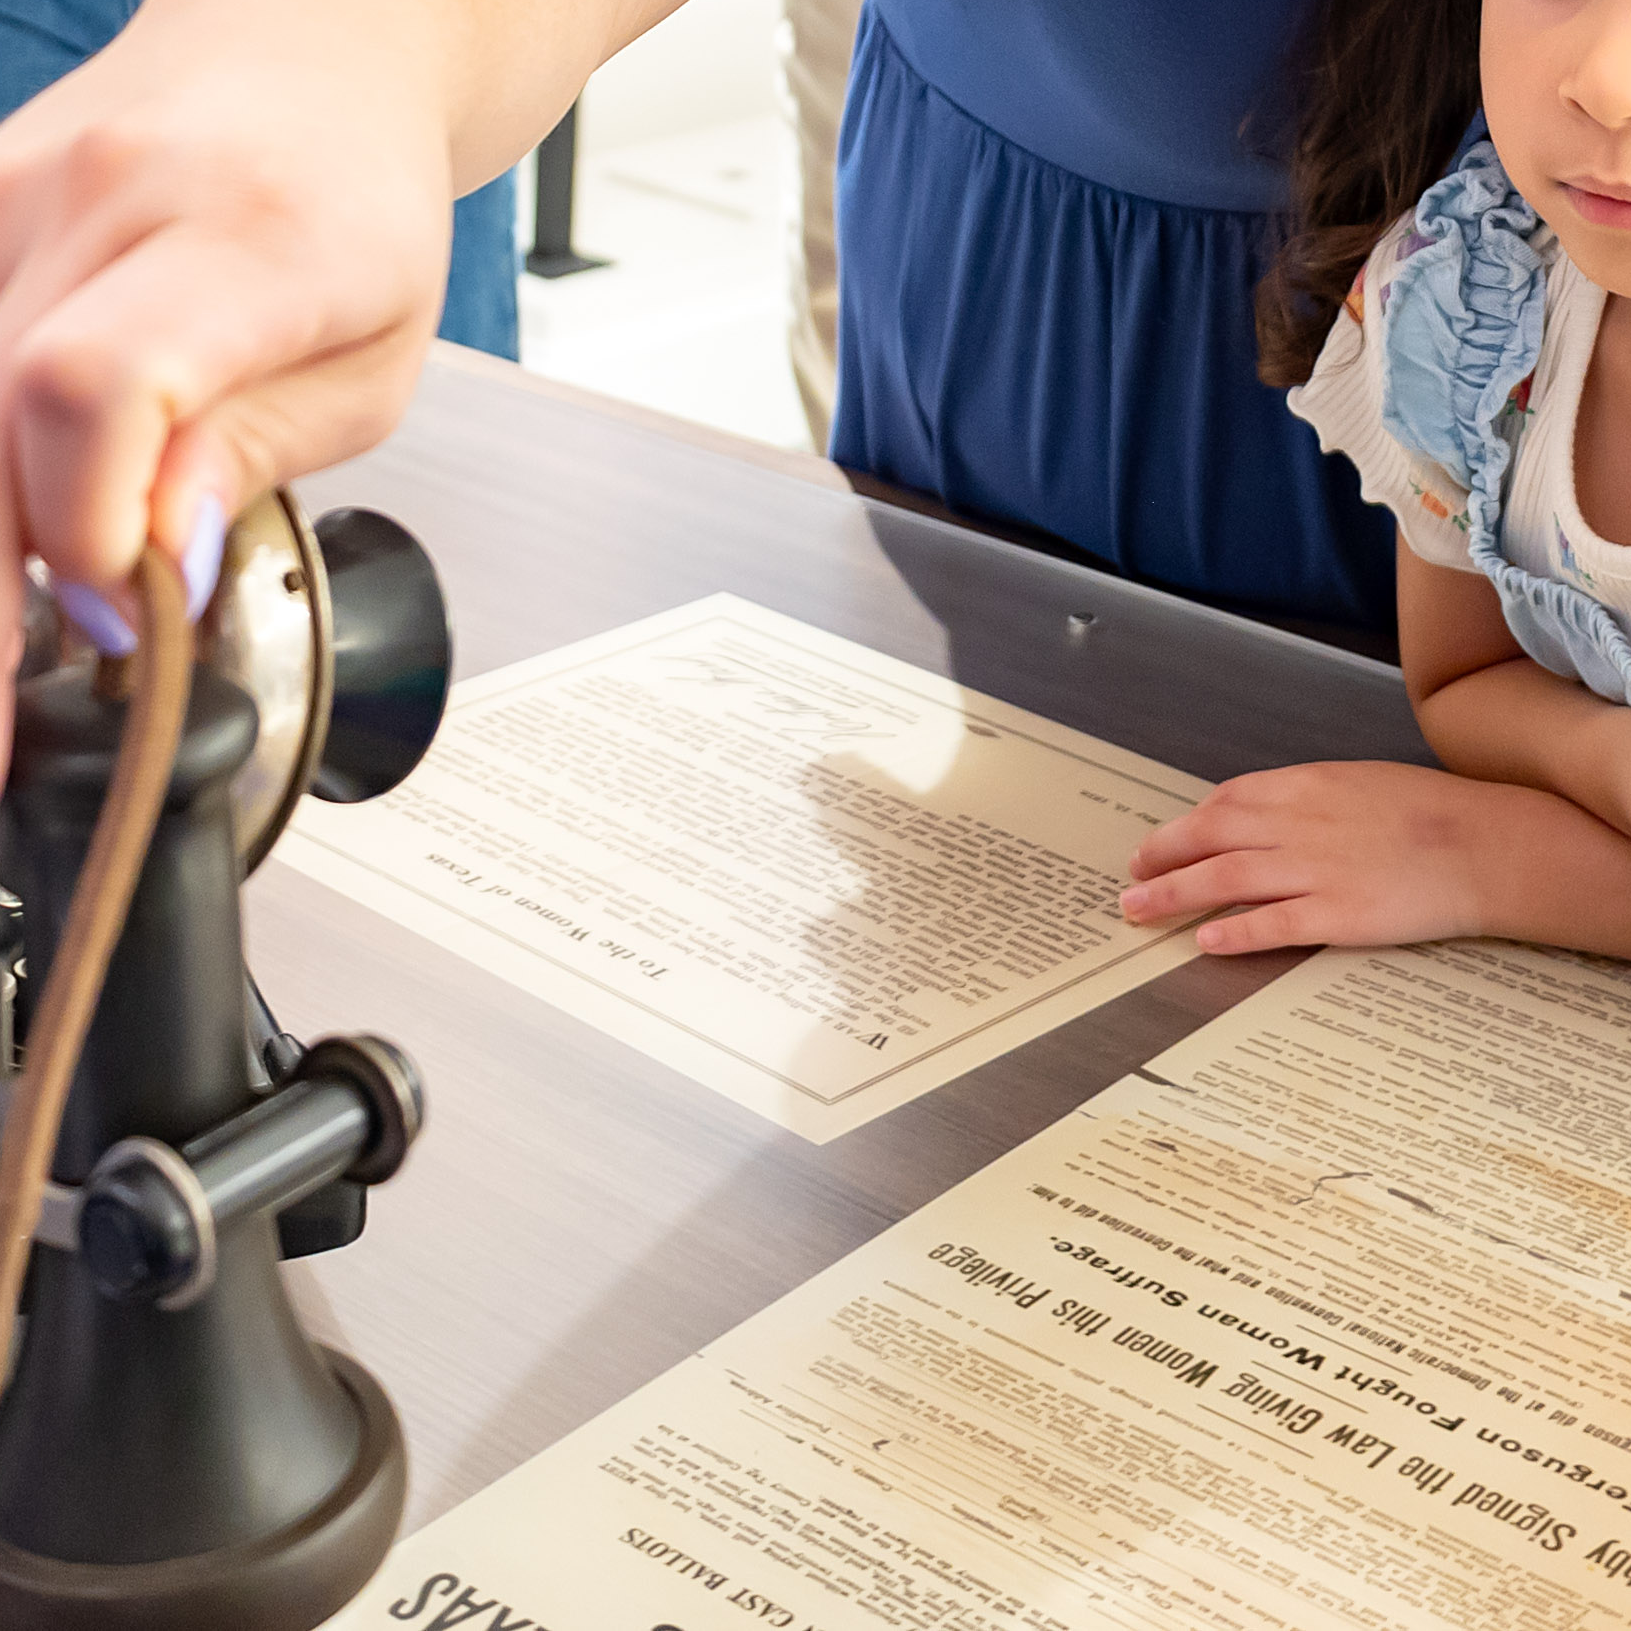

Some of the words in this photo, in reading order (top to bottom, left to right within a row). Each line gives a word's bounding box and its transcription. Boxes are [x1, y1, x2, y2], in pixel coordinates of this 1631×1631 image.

[420, 853, 484, 887] Texas
[478, 884, 513, 897] of
[510, 896, 593, 941] Women
[594, 939, 638, 960] the
[635, 959, 671, 981] To
[1056, 1196, 1077, 1209] to
[1070, 1203, 1102, 1219] did
[1095, 1213, 1175, 1252] Convention
[1042, 1234, 1193, 1308] Suffrage.
[1170, 1246, 1198, 1262] the
[1192, 1256, 1233, 1276] what
[922, 1241, 1056, 1310] Privilege
[1228, 1272, 1264, 1289] and
[1047, 1298, 1114, 1337] this
[1262, 1286, 1346, 1327] Convention
[1192, 1303, 1329, 1372] Woman
[1340, 1320, 1409, 1355] National
[1107, 1325, 1224, 1390] Women
[1405, 1348, 1494, 1392] Democratic
[1214, 1371, 1328, 1435] Giving
[1330, 1364, 1469, 1432] Fought
[1494, 1386, 1523, 1405] the
[1523, 1399, 1546, 1413] at
[1546, 1409, 1580, 1428] did
[1318, 1422, 1398, 1470] Law
[1394, 1455, 1457, 1495] the
[1447, 1481, 1581, 1553] Signed
[614, 1526, 733, 1591] BALLOTS
[722, 1586, 798, 1628] CAST
